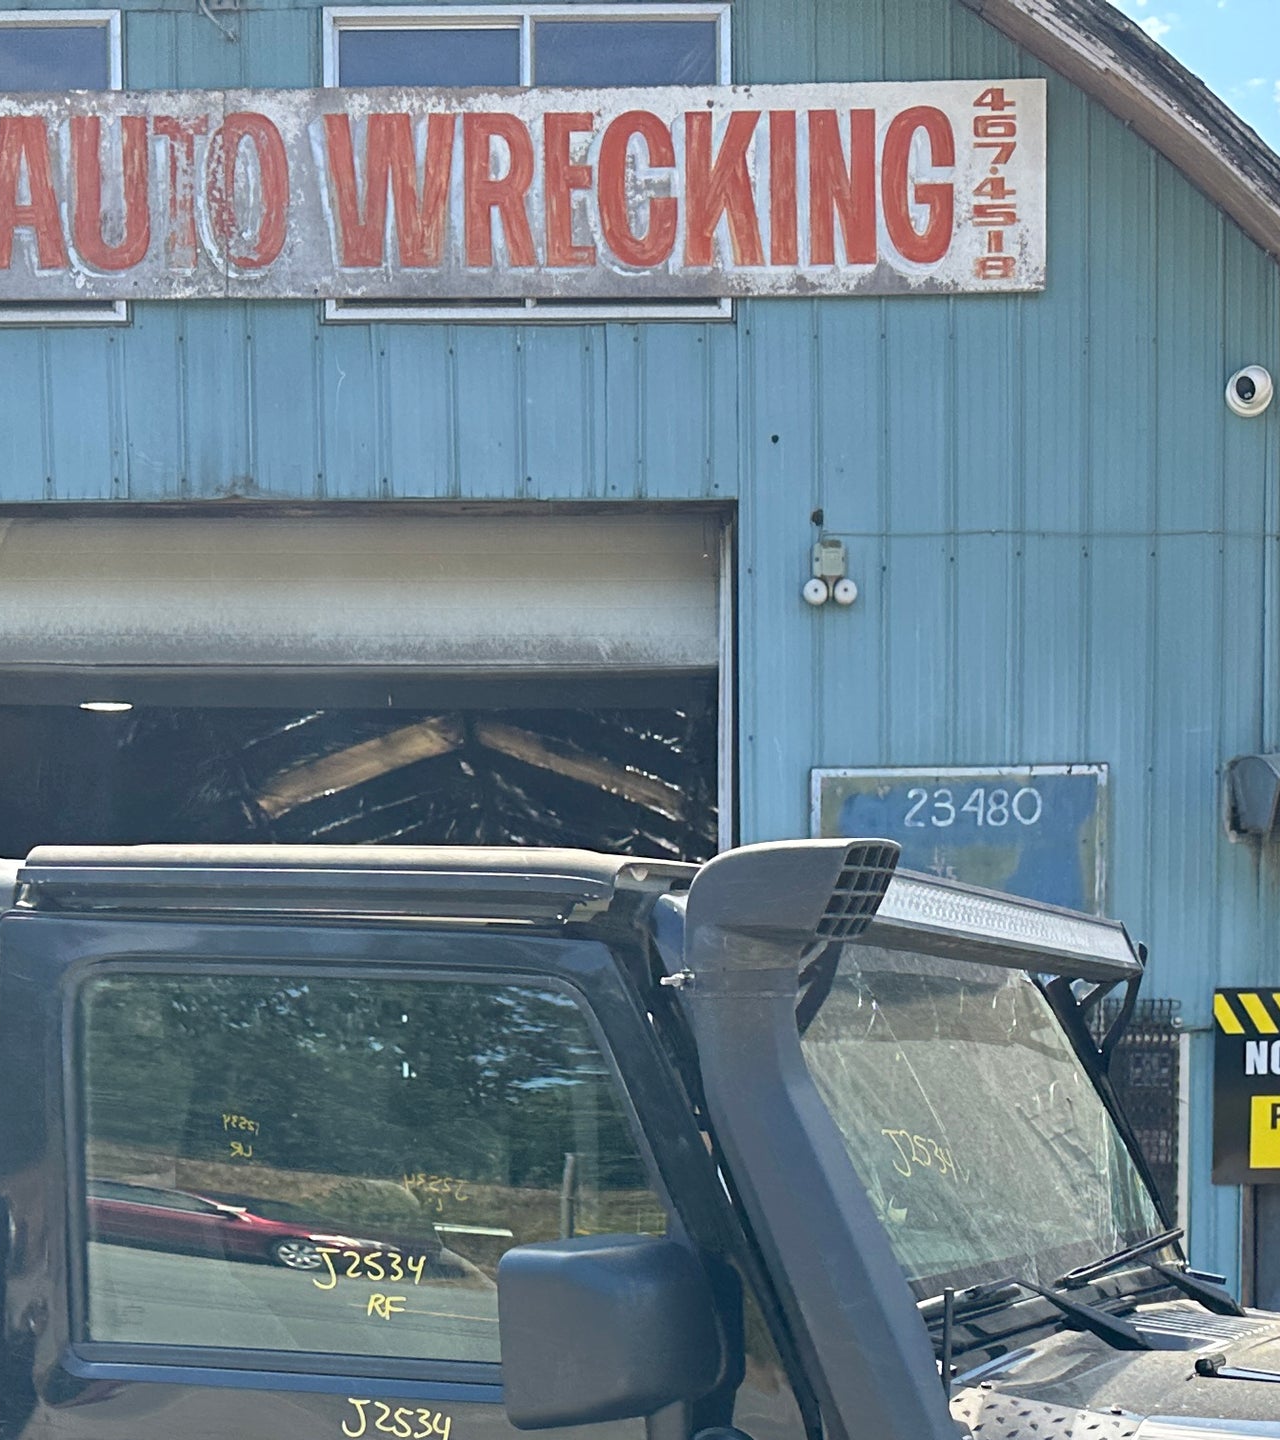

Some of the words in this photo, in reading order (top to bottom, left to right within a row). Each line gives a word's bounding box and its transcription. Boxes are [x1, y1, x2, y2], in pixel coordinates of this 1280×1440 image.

[322, 105, 956, 267] WRECKING
[903, 786, 1043, 828] 23480
[312, 1246, 428, 1291] J2534
[367, 1293, 407, 1321] RF
